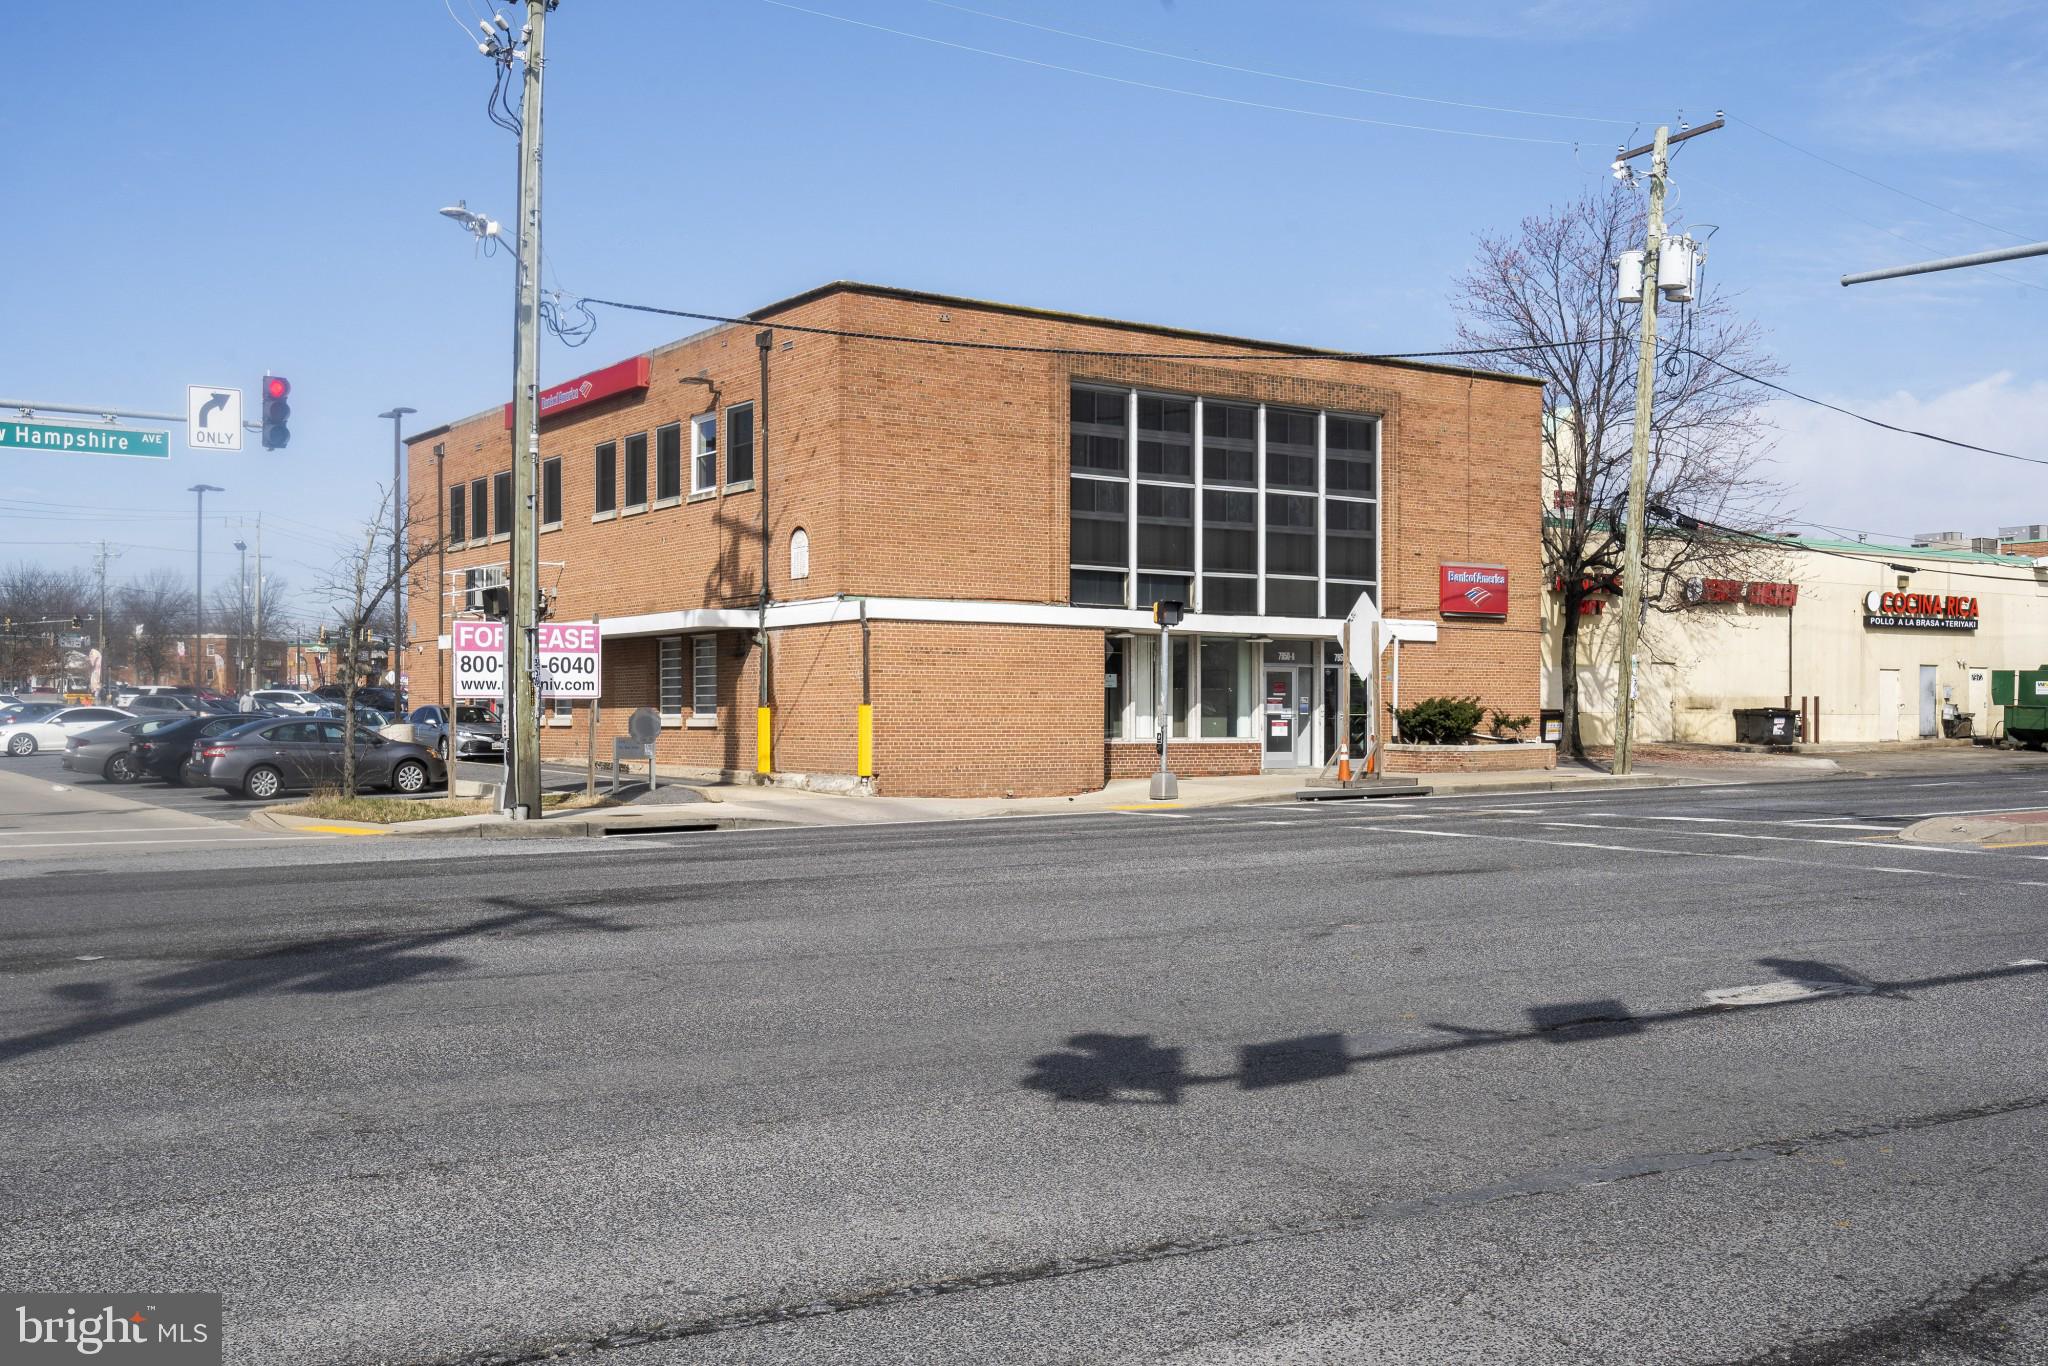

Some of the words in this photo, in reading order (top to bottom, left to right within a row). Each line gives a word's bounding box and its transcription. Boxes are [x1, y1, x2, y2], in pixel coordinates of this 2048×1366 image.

[16, 427, 129, 451] Hampshire
[142, 433, 163, 445] AVE
[196, 431, 234, 445] ONLY
[1881, 592, 1942, 615] COCINA
[1943, 596, 1980, 617] RICA
[1871, 617, 1894, 626] POLLO
[1915, 619, 1939, 628] BRASA
[1945, 620, 1977, 629] TERIYAKI
